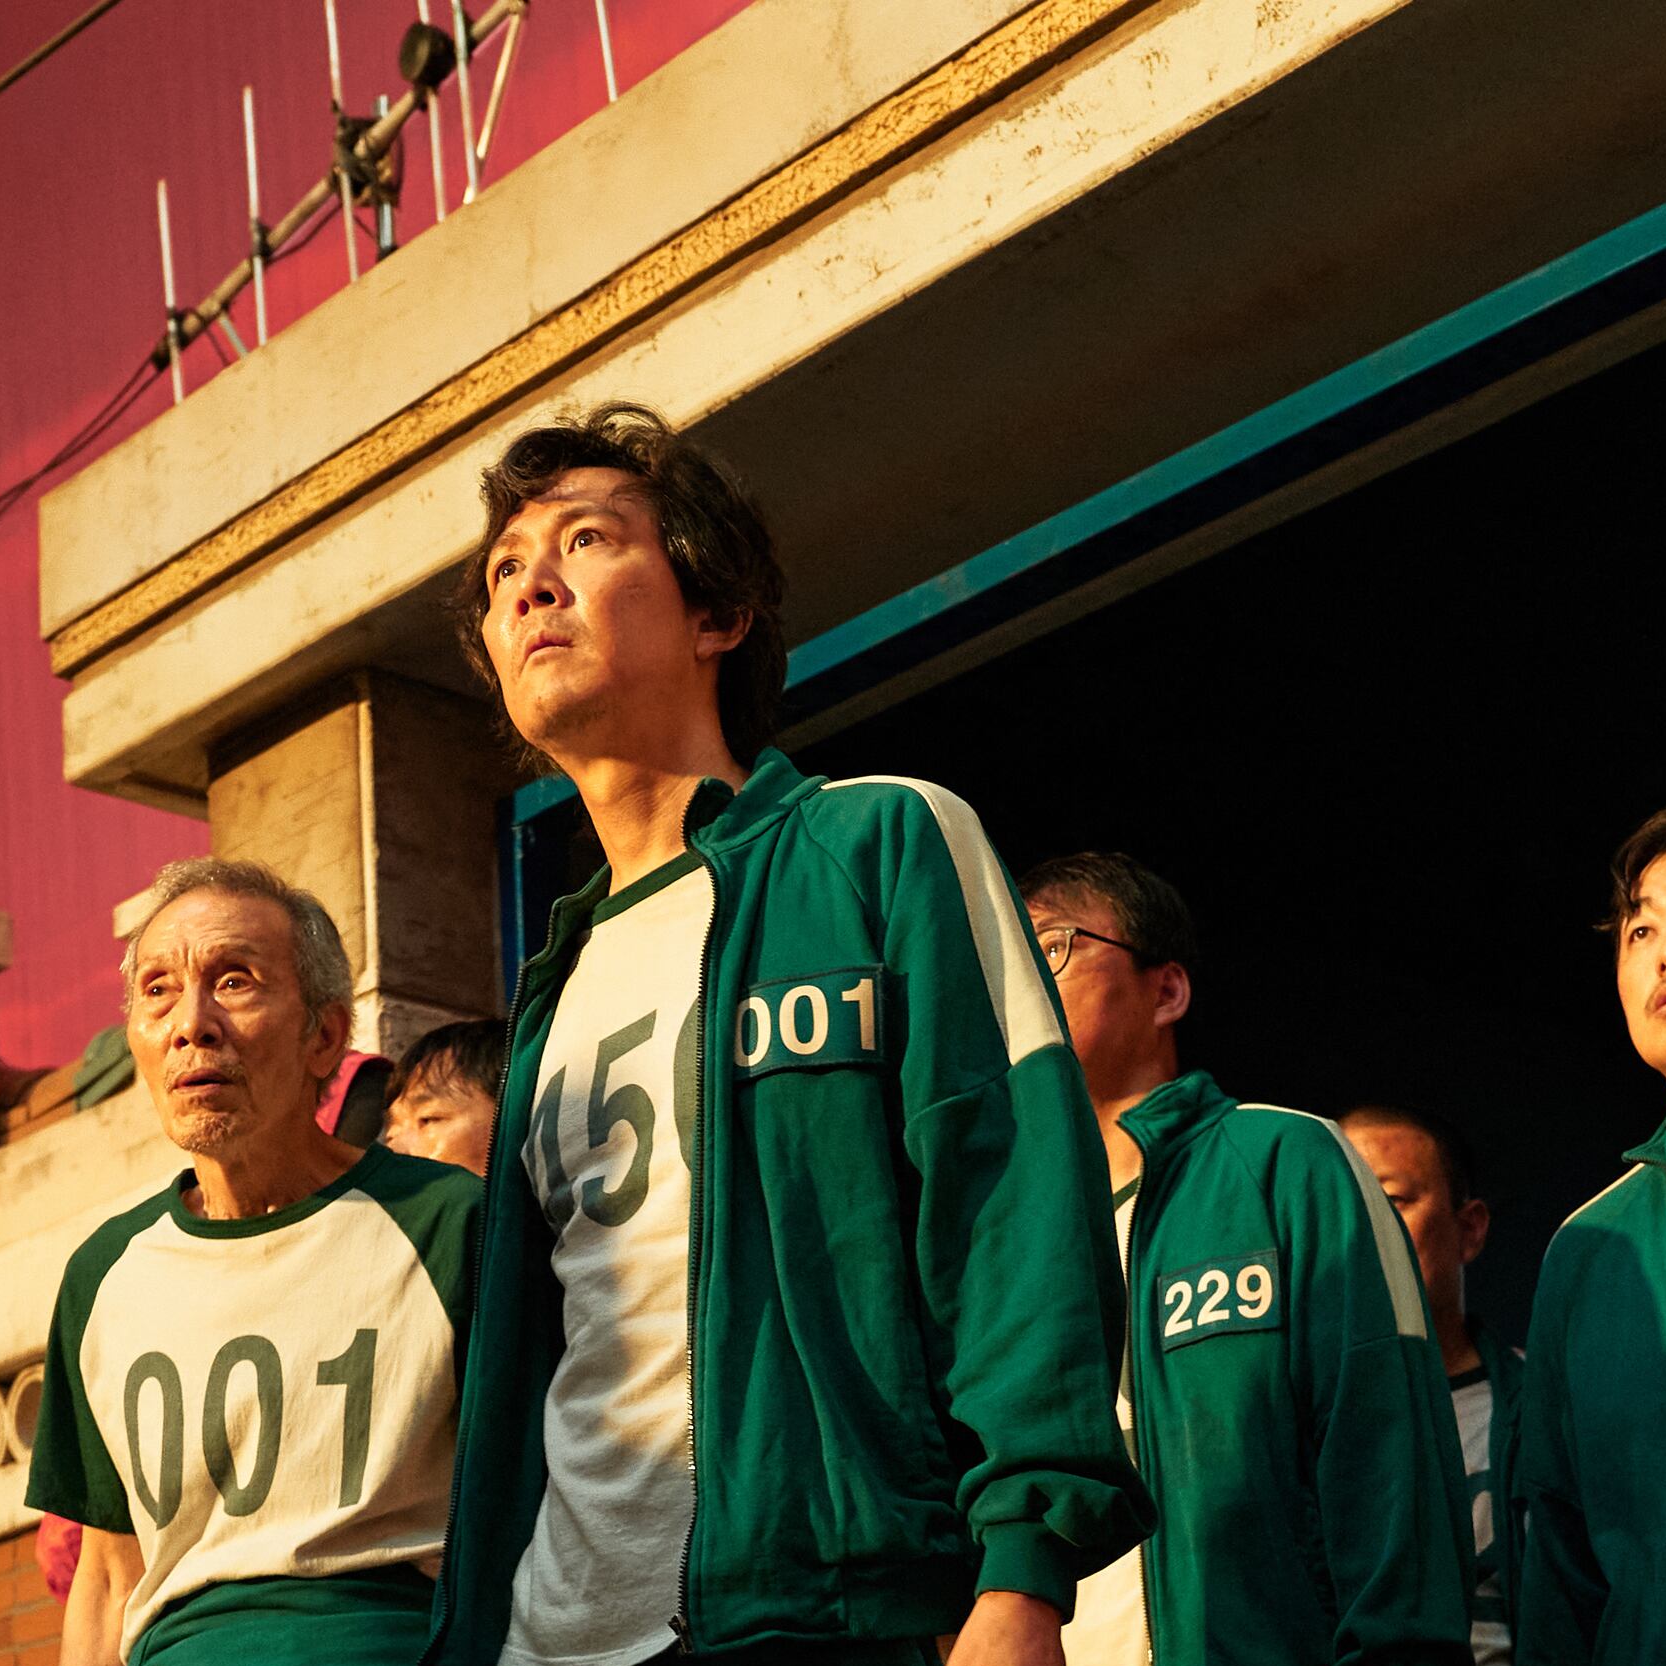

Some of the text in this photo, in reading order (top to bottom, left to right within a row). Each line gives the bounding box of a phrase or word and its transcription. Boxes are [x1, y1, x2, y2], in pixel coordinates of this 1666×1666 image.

[734, 977, 876, 1068] 001
[1163, 1263, 1274, 1338] 229
[123, 1327, 379, 1531] 001
